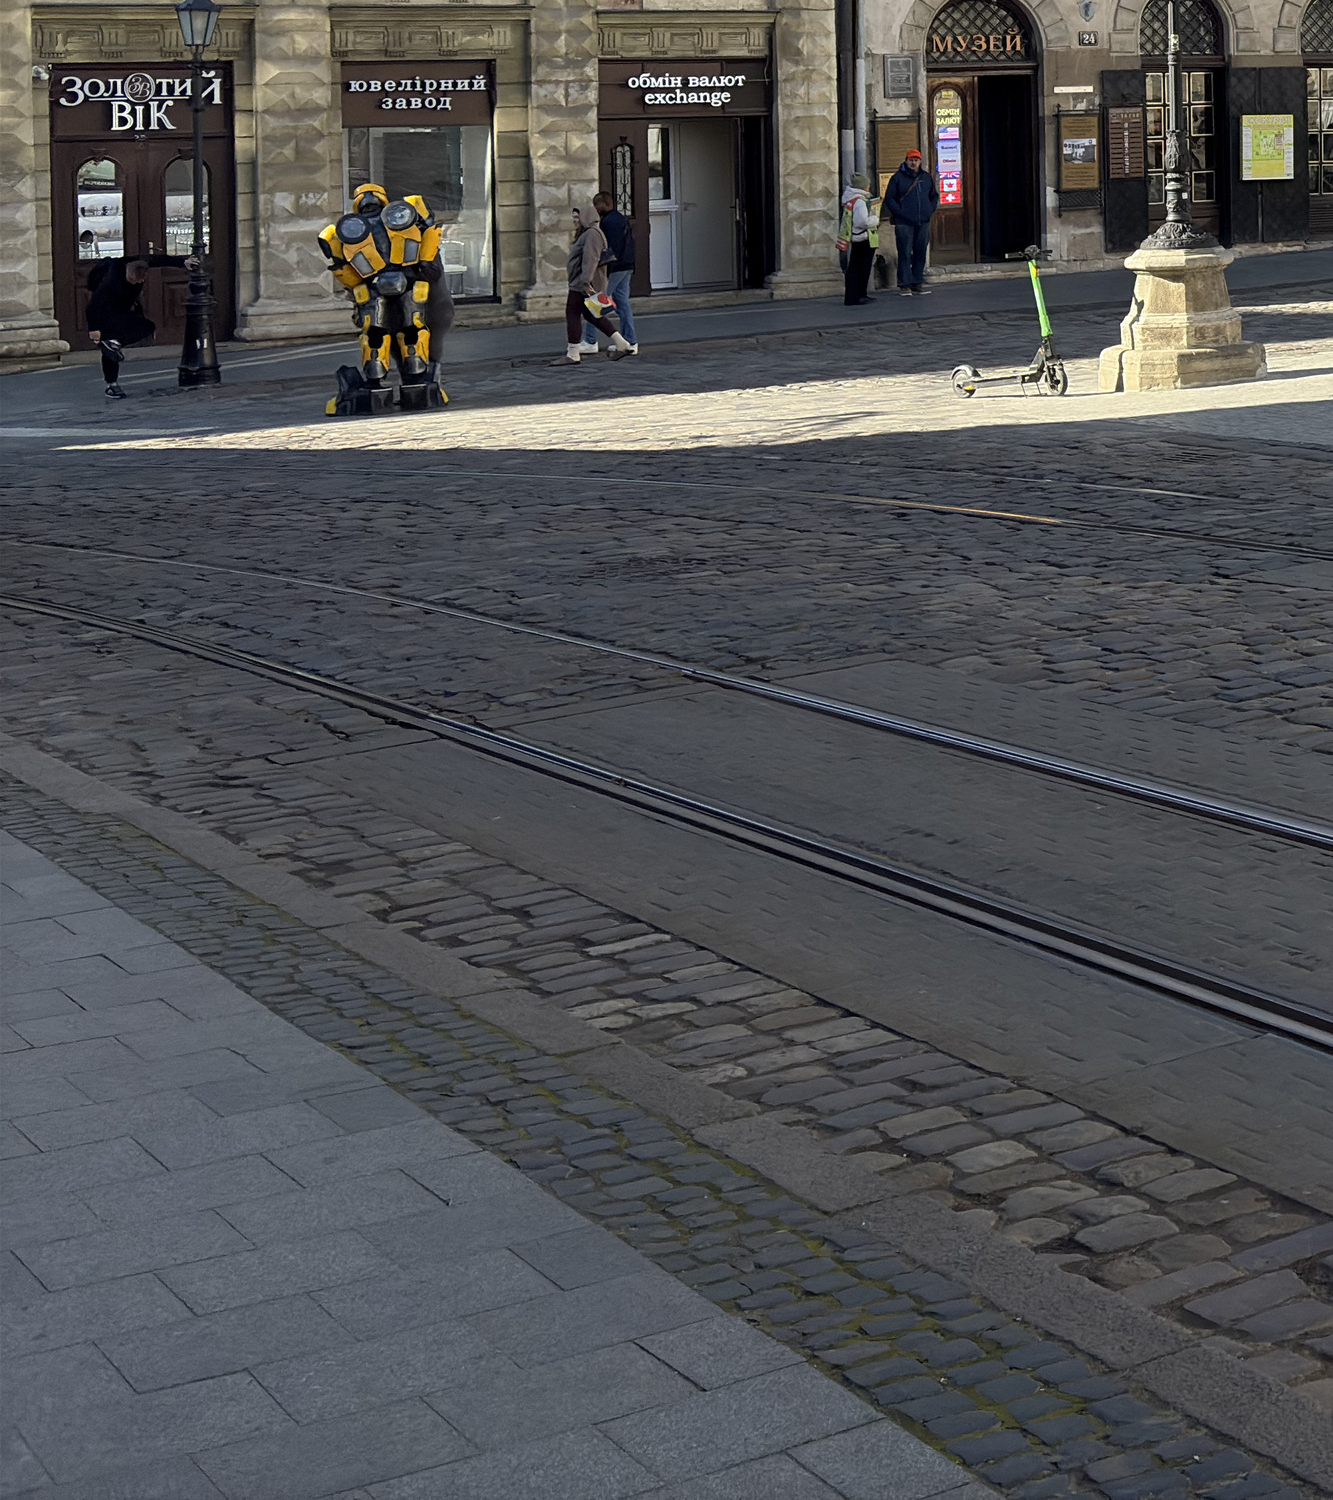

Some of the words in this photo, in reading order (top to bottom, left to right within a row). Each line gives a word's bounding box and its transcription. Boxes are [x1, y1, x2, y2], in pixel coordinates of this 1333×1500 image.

[932, 28, 1022, 53] МУЗЕЙ
[1083, 33, 1095, 44] 24
[349, 75, 487, 94] ювелірний
[628, 73, 682, 88] обмін
[688, 74, 746, 87] валют
[381, 97, 452, 110] завод
[644, 89, 731, 106] exchange
[110, 101, 177, 131] ВІК
[936, 108, 960, 116] ОБМІН
[936, 117, 960, 125] ВАЛЮТ
